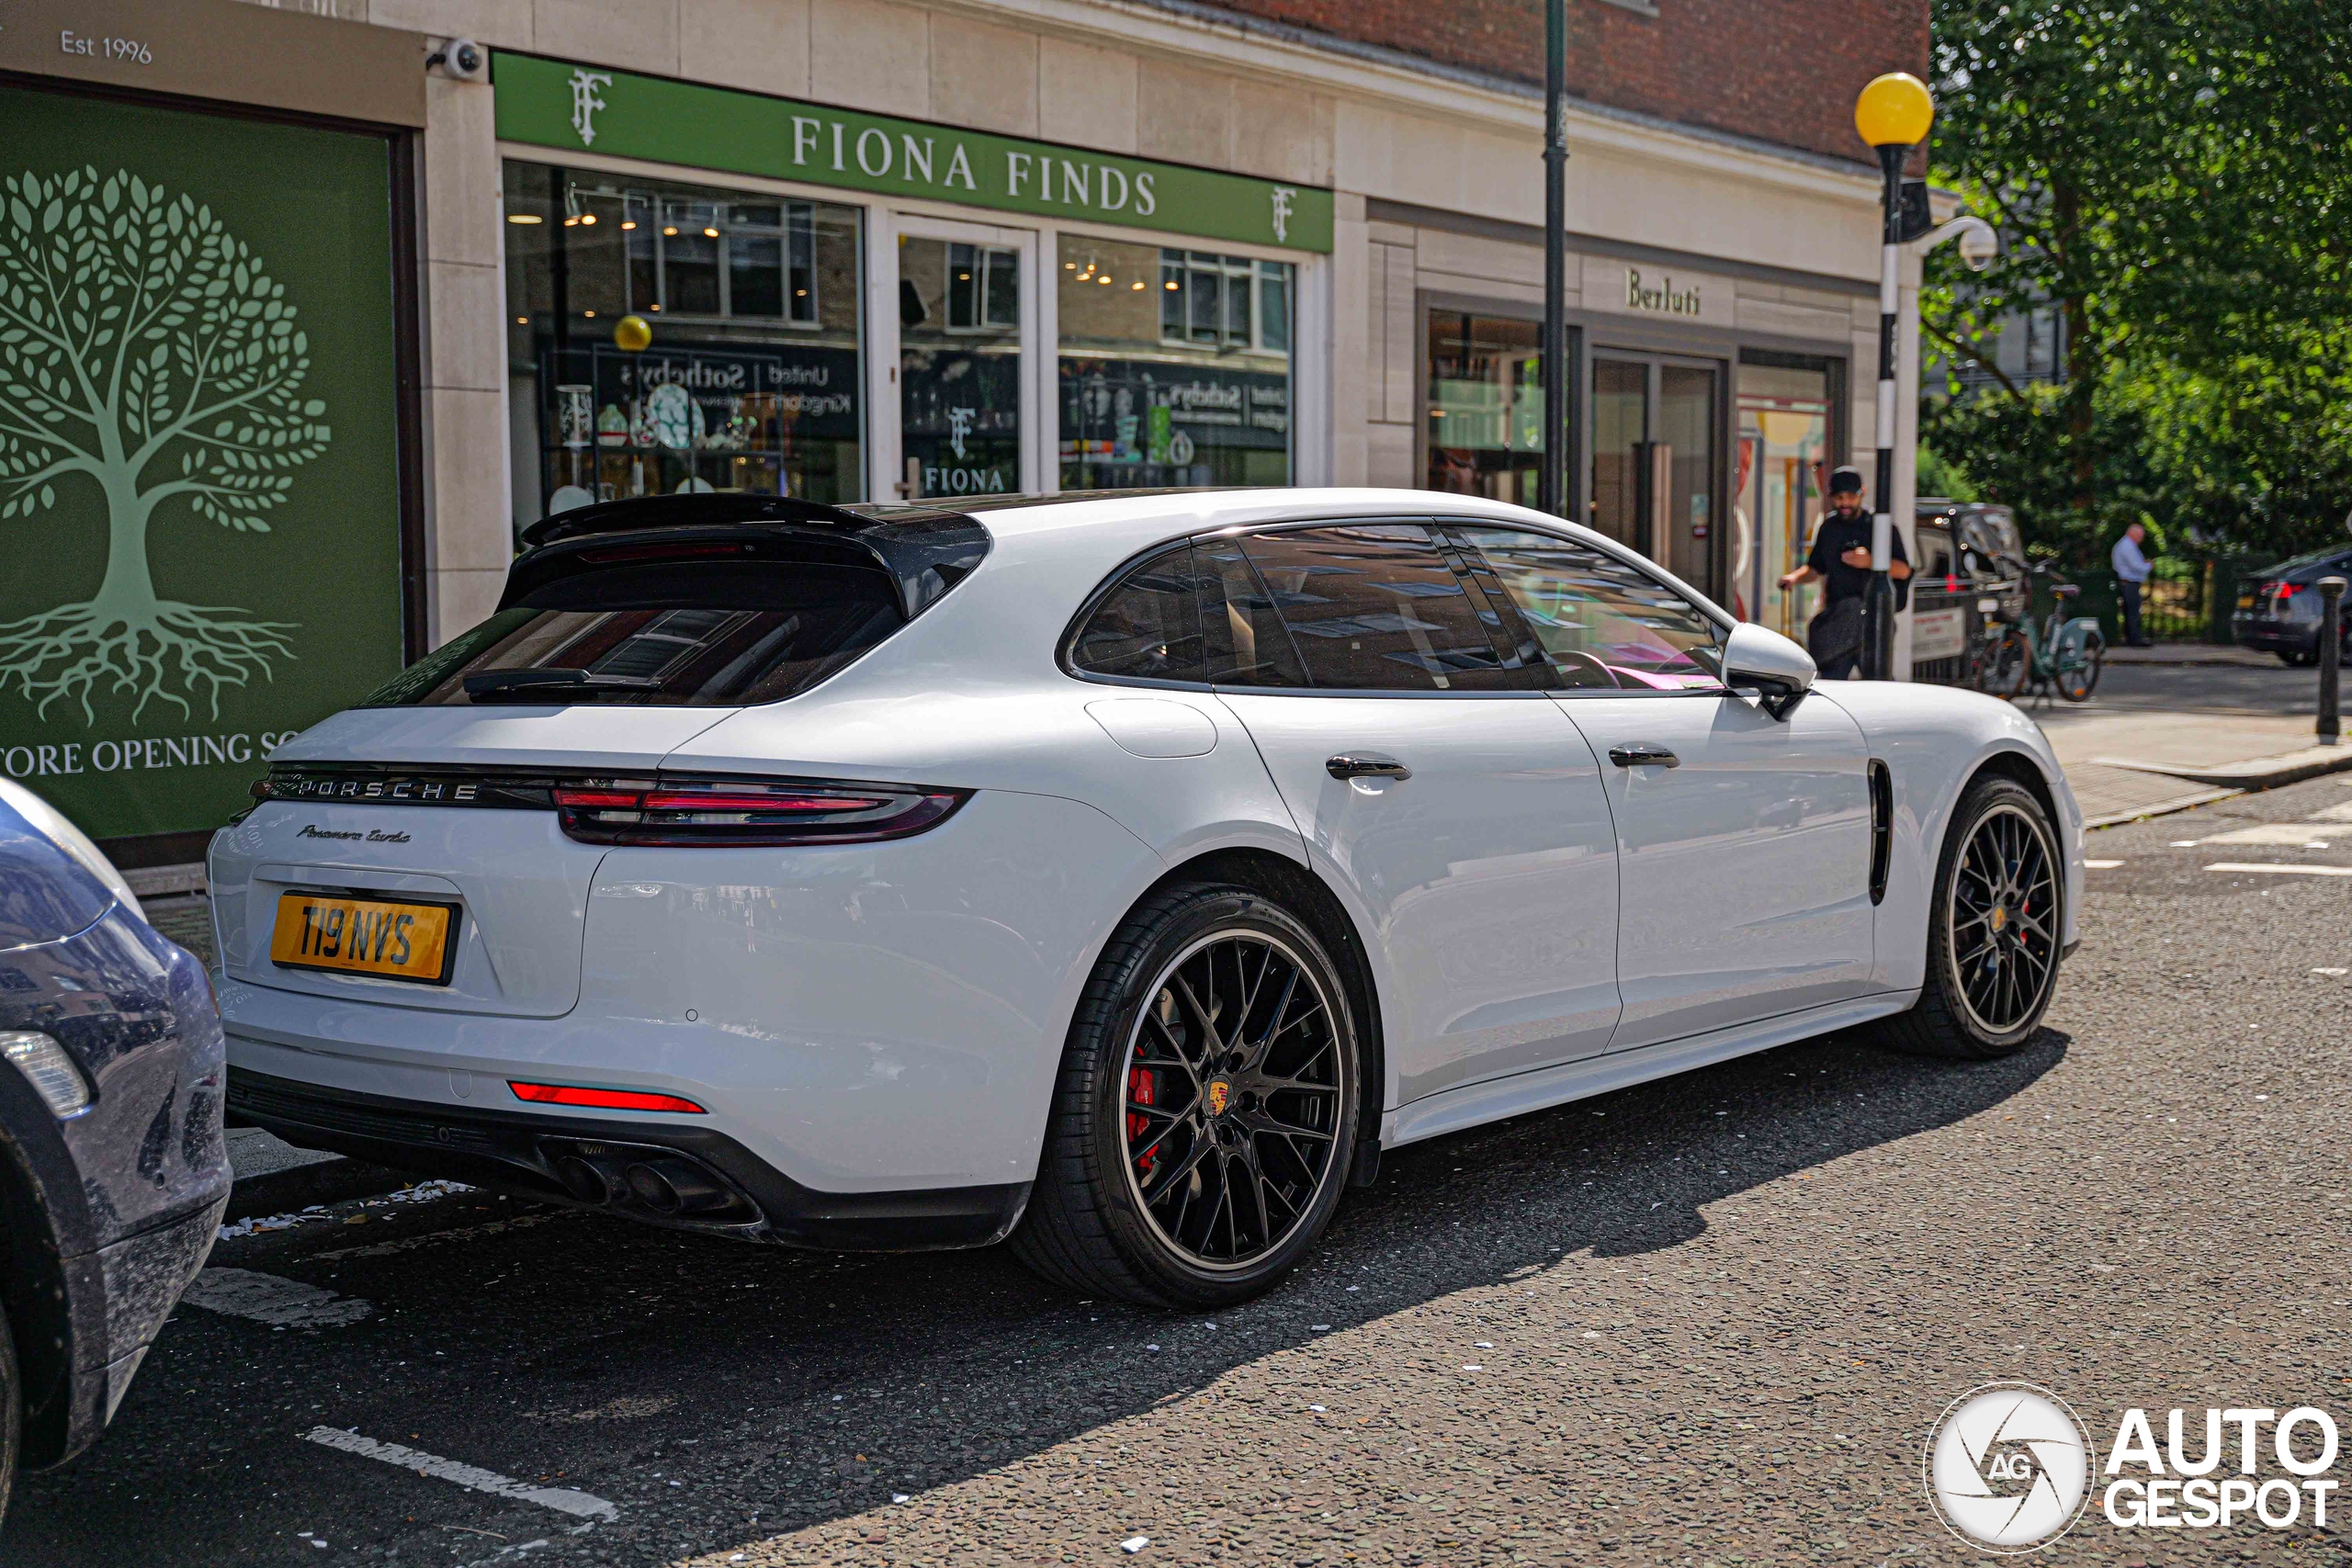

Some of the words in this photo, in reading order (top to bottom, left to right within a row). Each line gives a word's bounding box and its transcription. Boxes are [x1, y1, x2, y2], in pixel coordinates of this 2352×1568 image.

[61, 30, 95, 56] Est
[103, 38, 153, 64] 1996
[791, 116, 977, 191] FIONA
[1006, 152, 1157, 216] FINDS
[1624, 266, 1701, 316] Berluti
[924, 467, 1005, 492] FIONA
[0, 742, 85, 778] ORE
[92, 733, 253, 773] OPENING
[300, 782, 478, 800] PORSCHE
[296, 824, 364, 841] Panamera
[366, 829, 413, 843] turbo
[300, 905, 345, 957] T19
[347, 910, 414, 965] NVS
